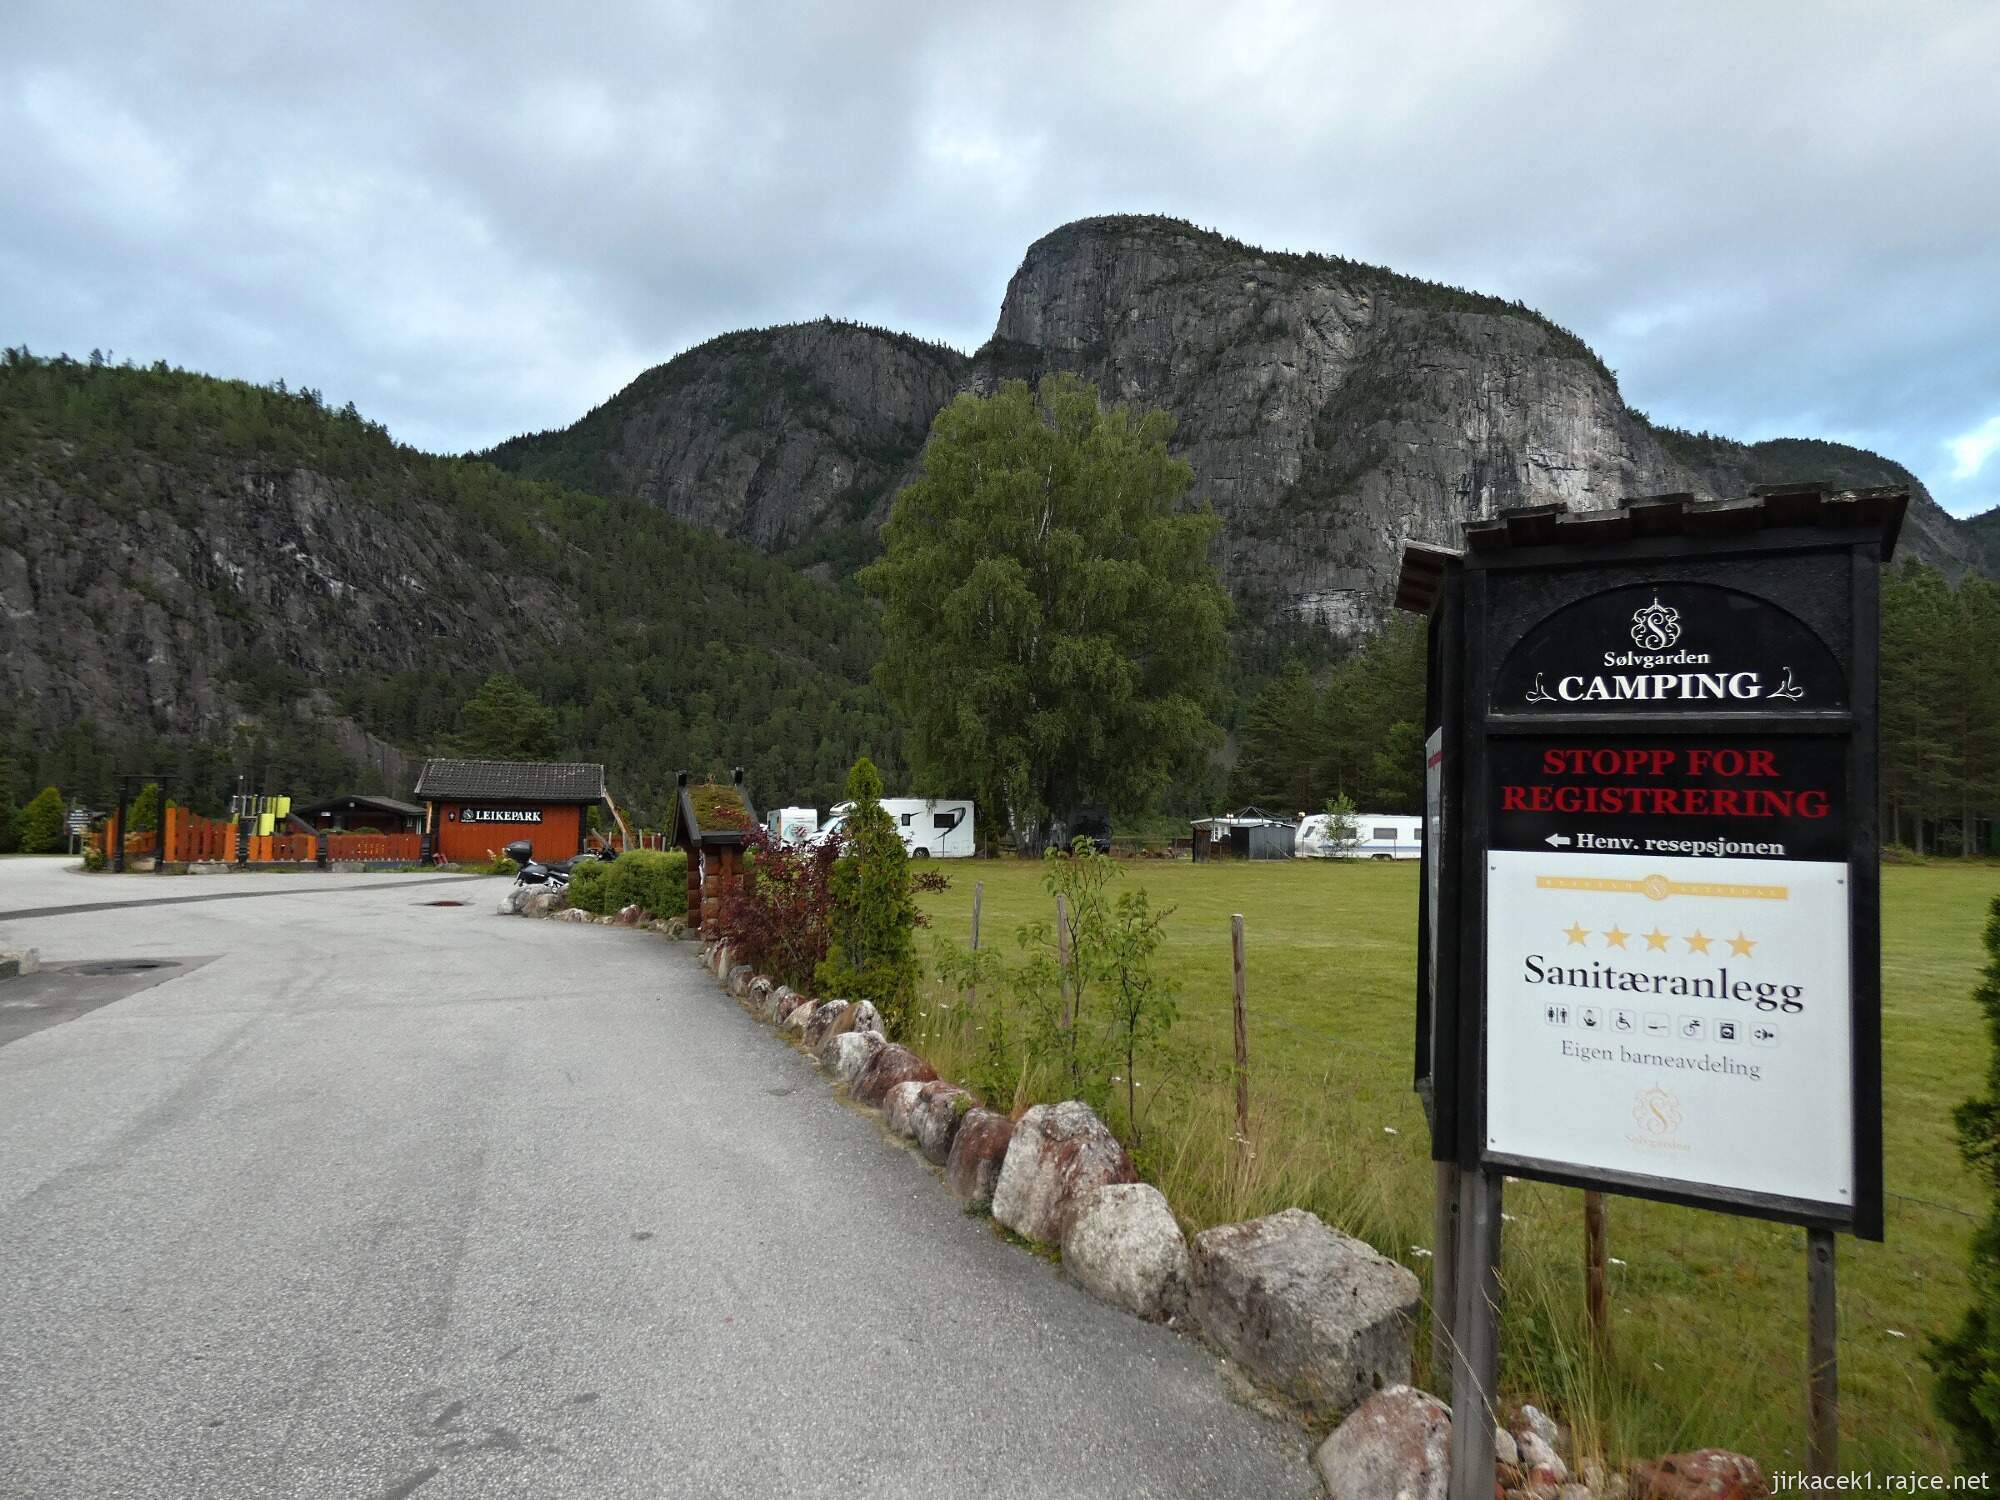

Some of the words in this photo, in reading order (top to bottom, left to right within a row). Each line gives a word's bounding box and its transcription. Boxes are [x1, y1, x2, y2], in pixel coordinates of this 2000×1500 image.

[1604, 650, 1710, 669] Sølvgarden
[1558, 672, 1762, 701] CAMPING
[1543, 748, 1675, 776] STOPP
[1685, 750, 1779, 778] FOR
[476, 810, 541, 822] LEIKEPARK
[1501, 786, 1830, 818] REGISTRERING
[1576, 833, 1640, 851] Henv.
[1644, 836, 1785, 857] resepsjonen
[1524, 954, 1804, 1012] Sanitæranlegg
[1561, 1039, 1613, 1063] Eigen
[1619, 1044, 1761, 1080] barneavdeling
